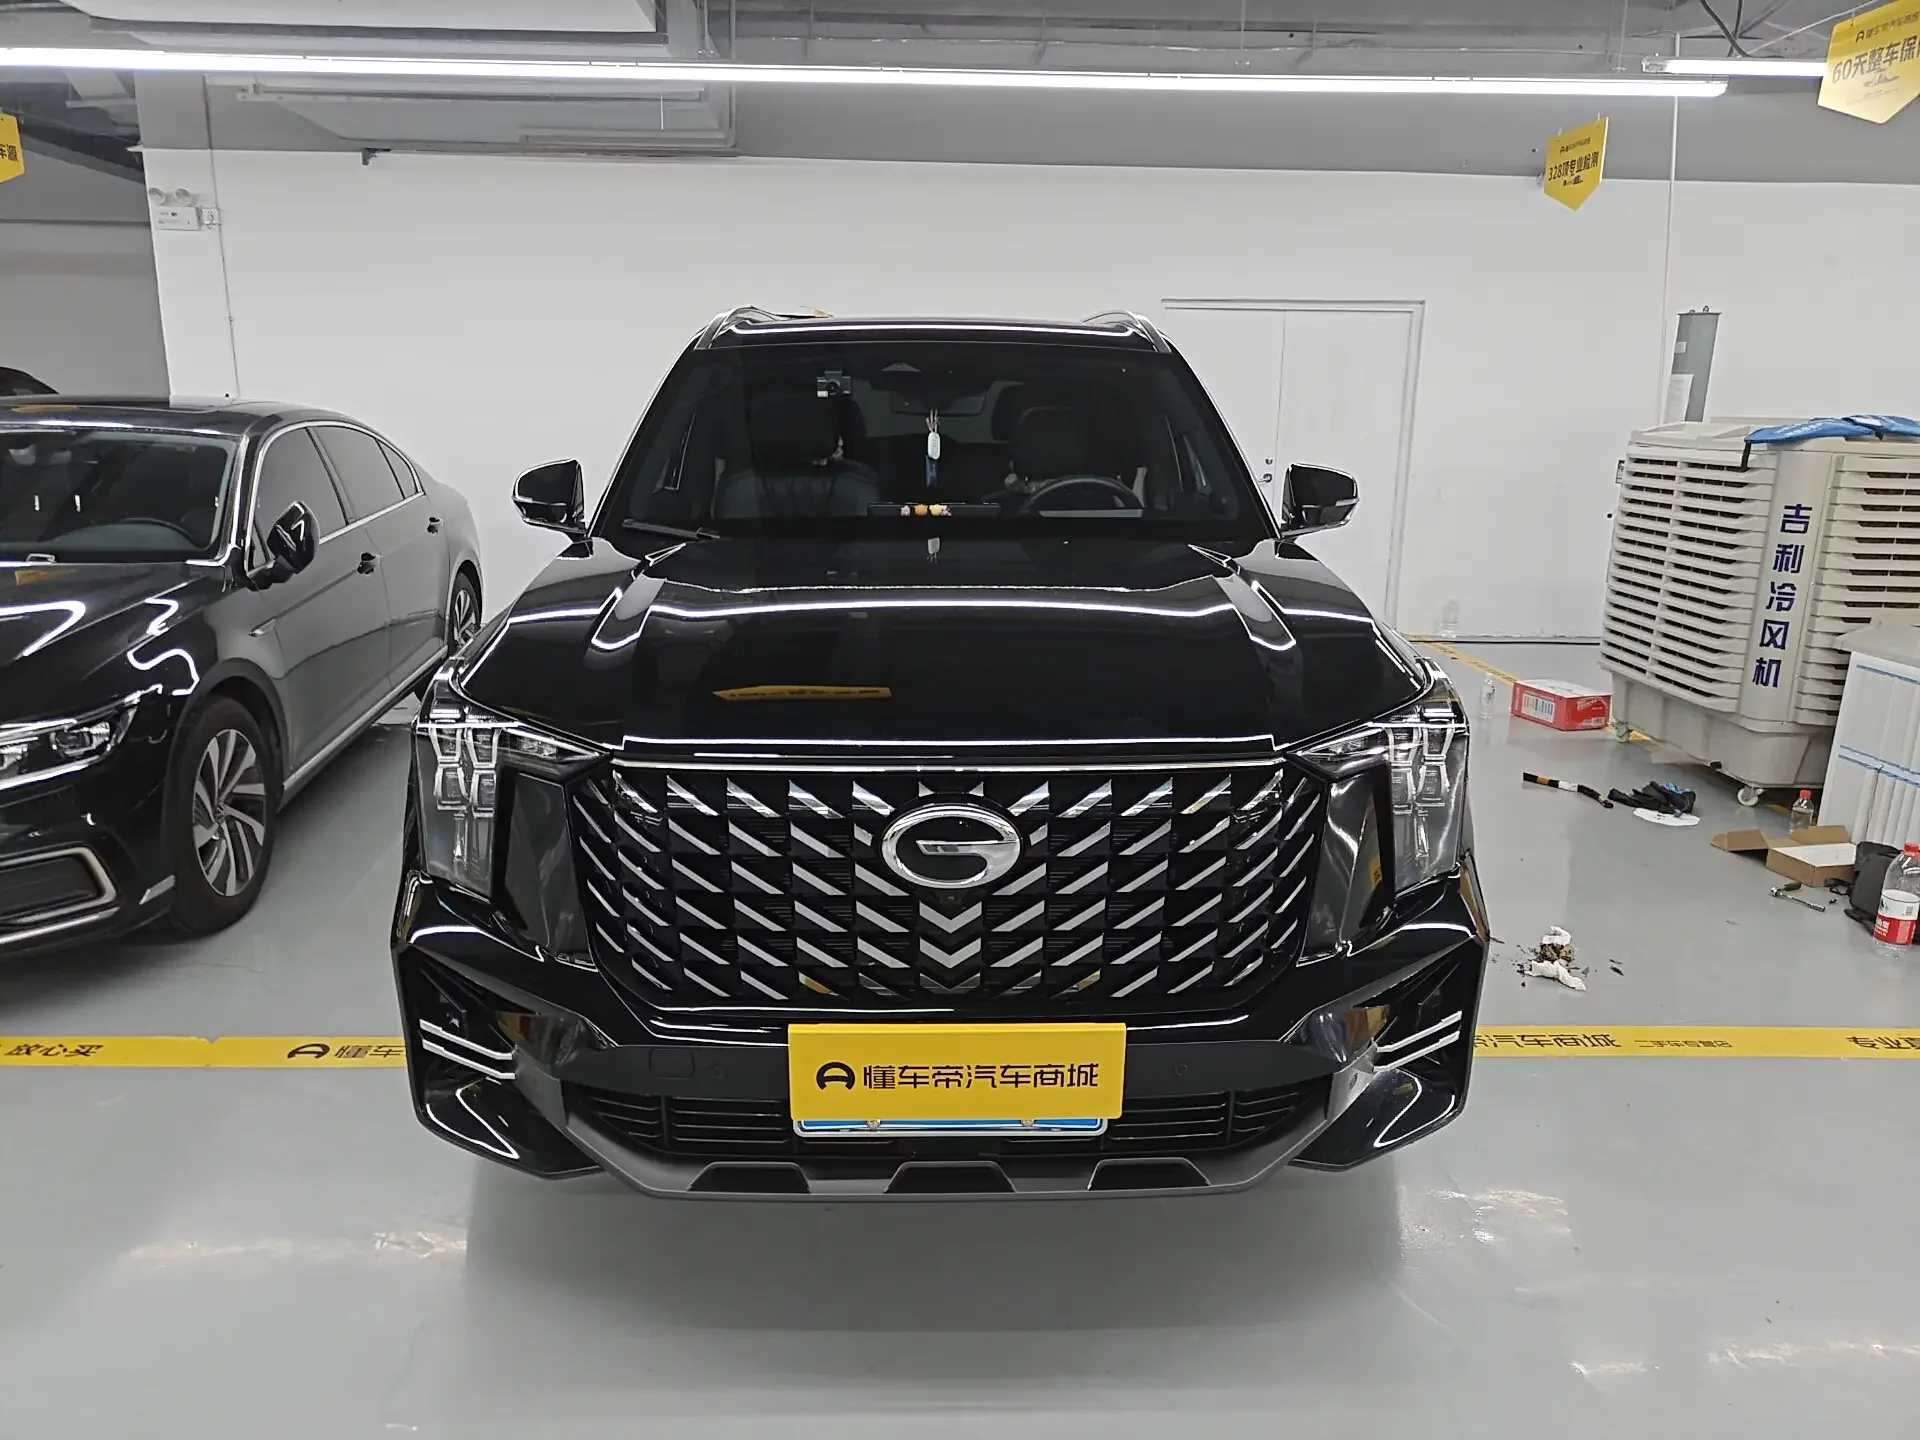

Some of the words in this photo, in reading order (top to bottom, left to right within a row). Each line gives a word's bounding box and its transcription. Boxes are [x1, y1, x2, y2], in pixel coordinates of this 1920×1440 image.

[1832, 35, 1920, 84] 60天整车保
[1752, 503, 1813, 688] 吉利冷风机
[862, 1063, 1099, 1090] 懂车帝汽车商城
